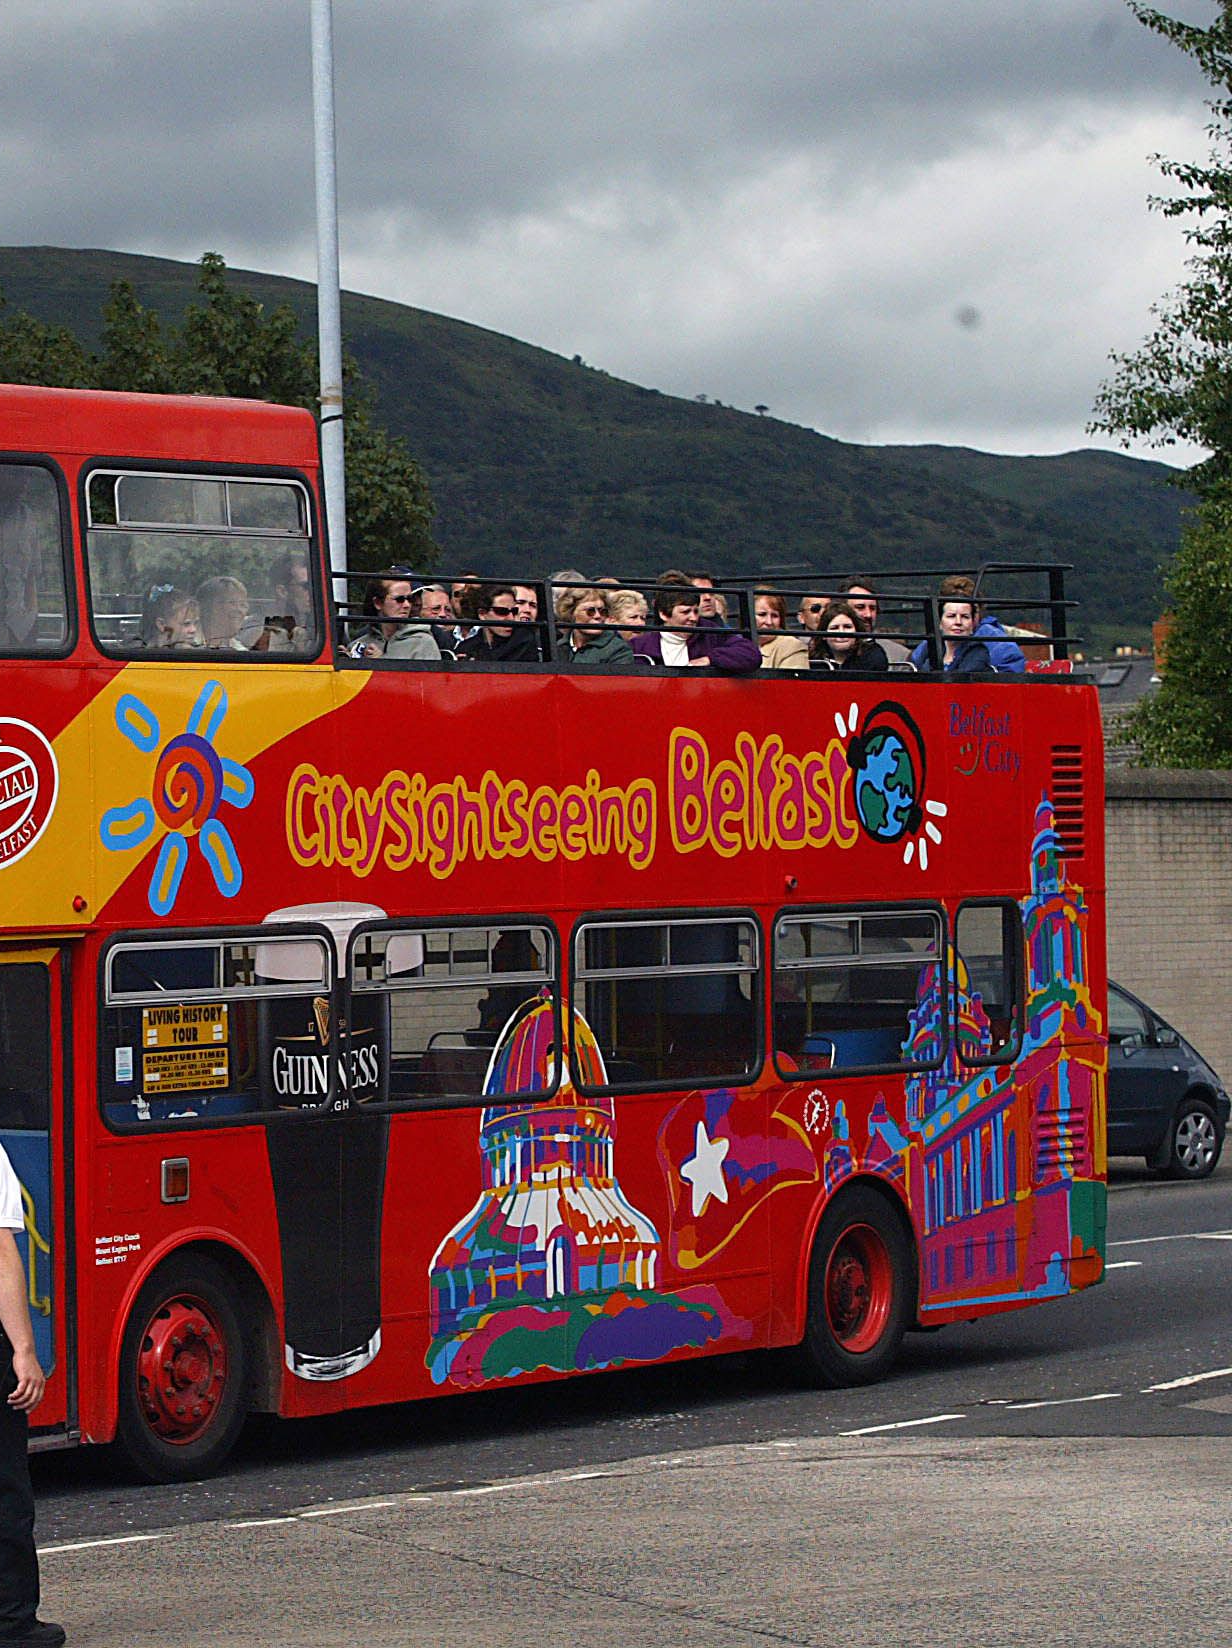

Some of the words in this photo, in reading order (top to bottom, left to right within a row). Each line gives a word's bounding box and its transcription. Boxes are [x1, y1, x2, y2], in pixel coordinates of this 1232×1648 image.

[950, 703, 1011, 754] Belfast
[984, 741, 1020, 781] City
[669, 726, 859, 858] Belfast
[148, 1009, 180, 1026] LIVING
[182, 1006, 223, 1023] HISTORY
[172, 1026, 199, 1043] TOUR
[145, 1051, 197, 1064] DEPARTURE
[198, 1050, 225, 1060] TIMES
